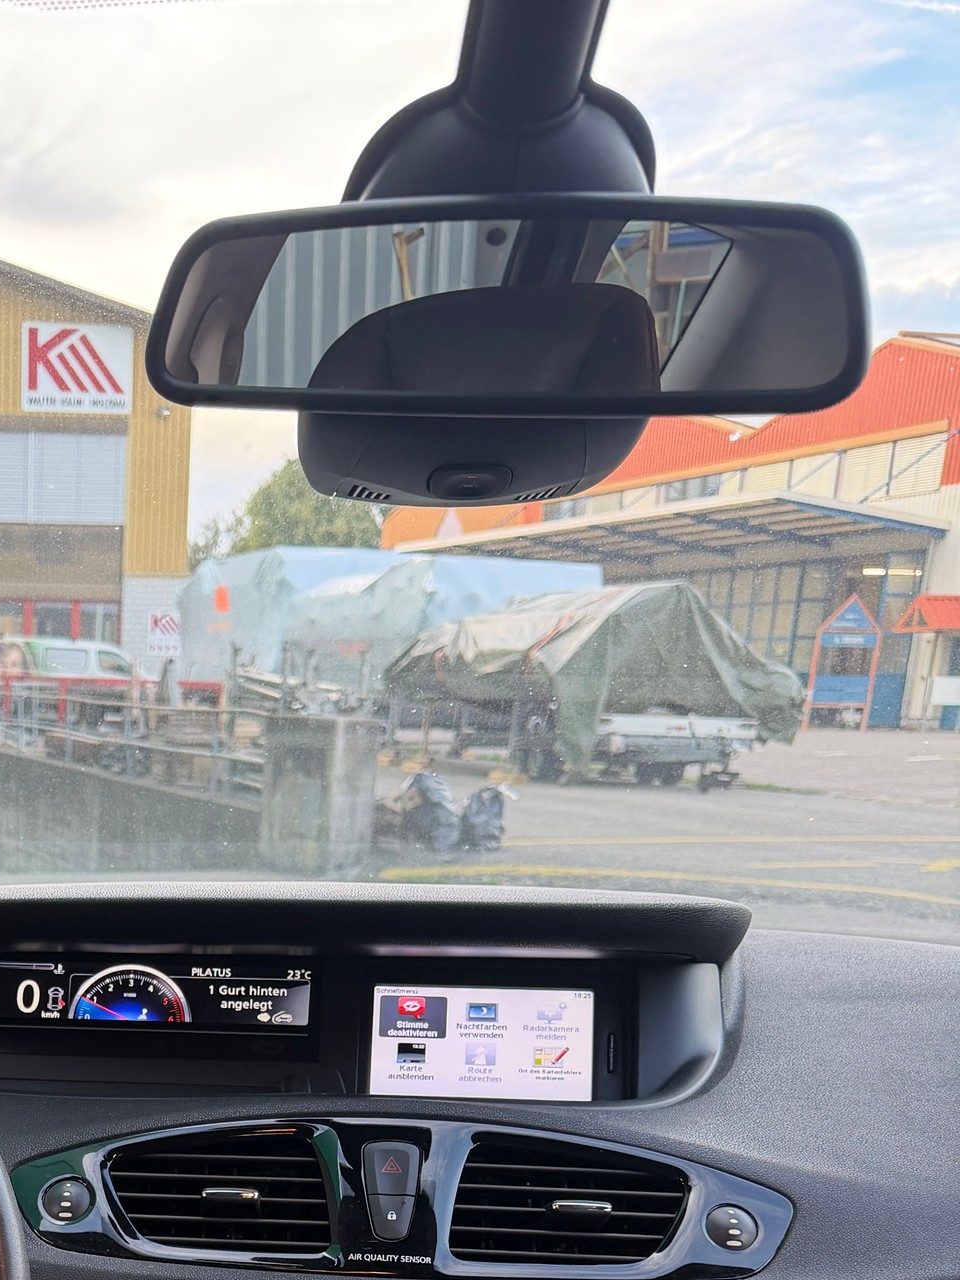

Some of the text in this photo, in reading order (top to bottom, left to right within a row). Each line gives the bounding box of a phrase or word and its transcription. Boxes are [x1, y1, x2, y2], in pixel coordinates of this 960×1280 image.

[191, 967, 232, 977] PILATUS
[128, 979, 134, 987] 3
[108, 984, 114, 992] 2
[147, 984, 154, 993] 4
[209, 985, 288, 997] 1 Gurt hinten
[16, 979, 41, 1014] 0
[162, 997, 168, 1006] 5
[220, 999, 273, 1011] angelegt
[41, 1010, 60, 1019] km/h
[396, 1021, 429, 1029] Stimme
[456, 1022, 507, 1031] Nachtfarben
[523, 1025, 579, 1033] Radarkamera
[387, 1029, 438, 1038] deaktivieren
[388, 1073, 434, 1081] ausblenden
[459, 1075, 502, 1083] abbrechen
[348, 1253, 432, 1264] AIR QUALITY SENSOR
